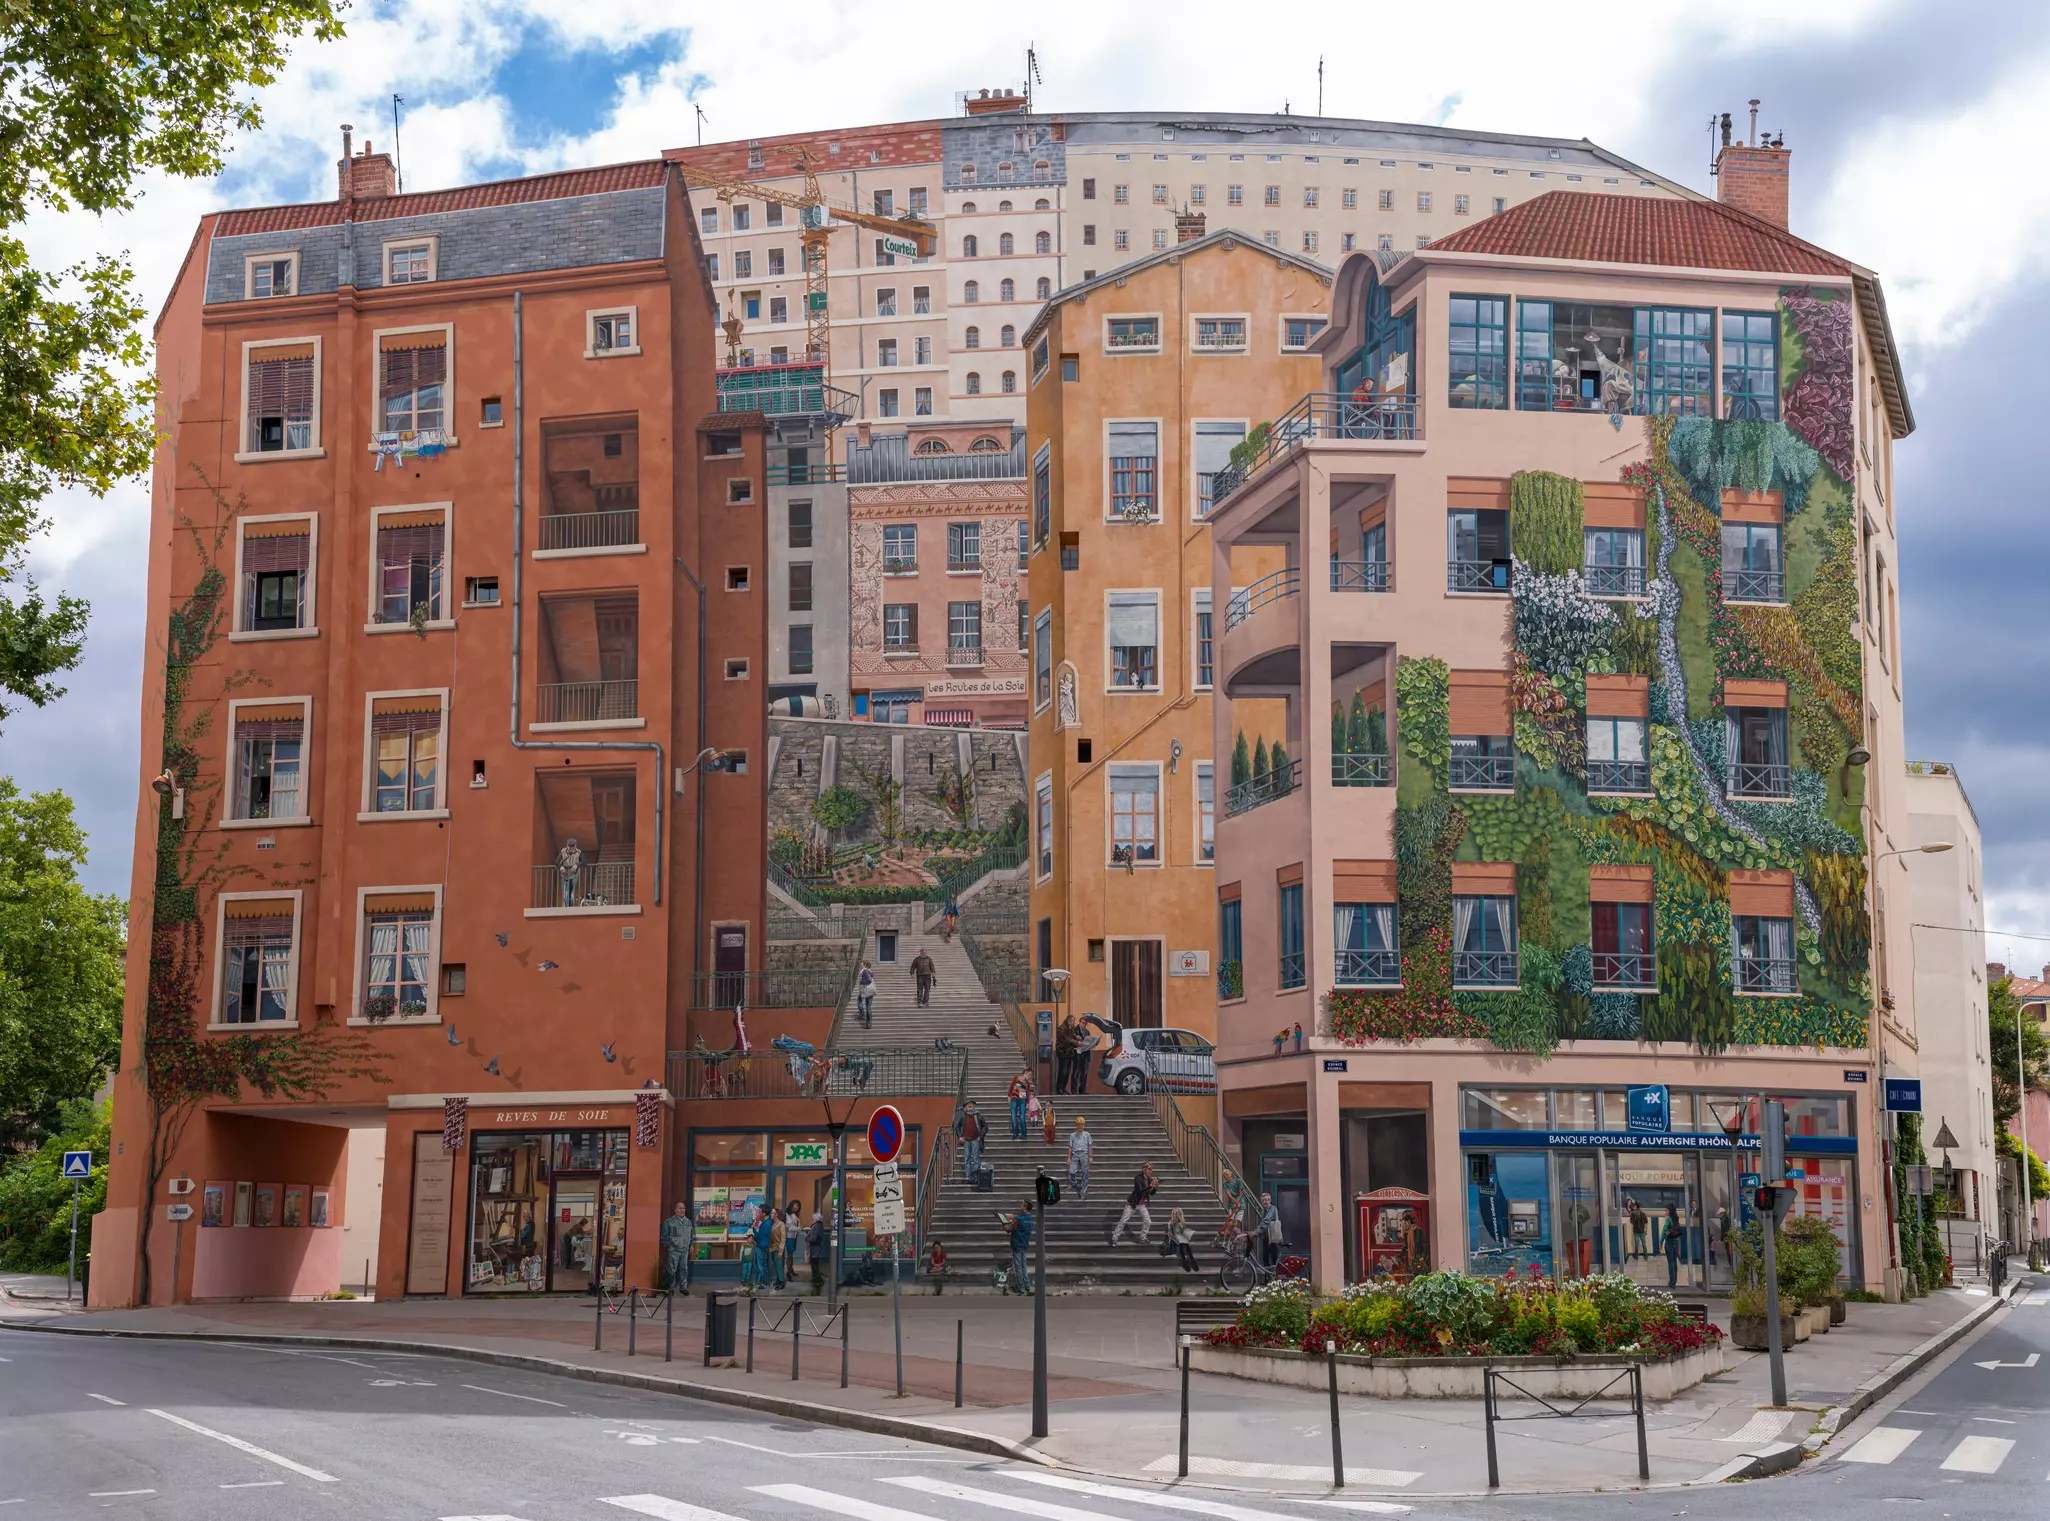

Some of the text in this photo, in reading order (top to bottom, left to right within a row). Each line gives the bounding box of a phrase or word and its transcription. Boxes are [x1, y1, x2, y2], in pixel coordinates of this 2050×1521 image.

[885, 237, 917, 257] Courteix
[928, 682, 944, 693] Les
[945, 681, 978, 692] Routes
[980, 681, 991, 691] de
[1005, 680, 1025, 691] Soie
[496, 1110, 609, 1122] REVES DE SOIE
[1632, 1120, 1662, 1128] POPULAIRE
[1549, 1135, 1587, 1145] BANQUE
[1589, 1135, 1637, 1145] POPULAIRE
[1640, 1136, 1696, 1146] AUVERGNE
[1737, 1138, 1762, 1147] ALPE
[1805, 1176, 1841, 1184] ASSURANCE
[1328, 1204, 1335, 1213] 3
